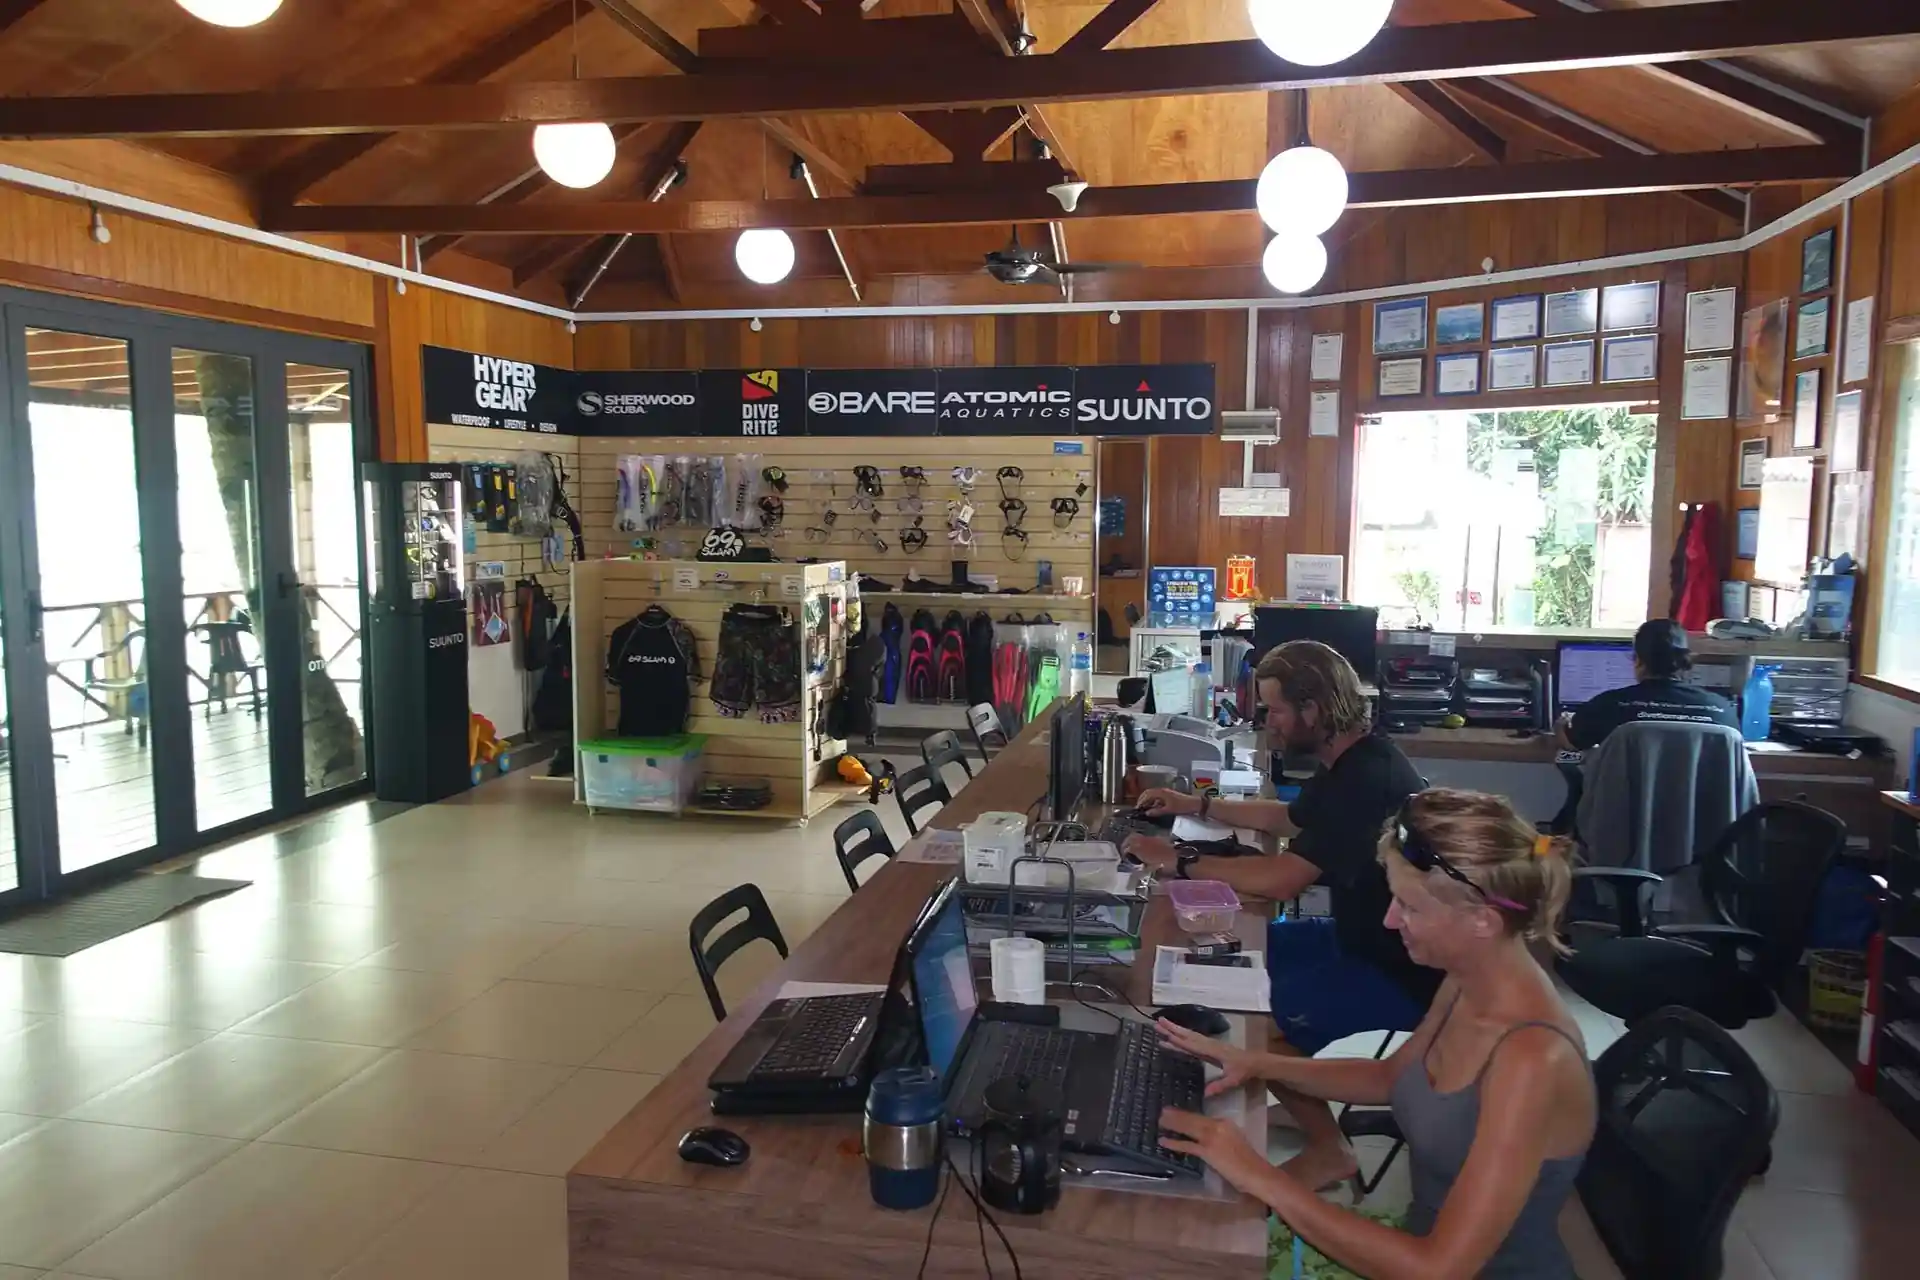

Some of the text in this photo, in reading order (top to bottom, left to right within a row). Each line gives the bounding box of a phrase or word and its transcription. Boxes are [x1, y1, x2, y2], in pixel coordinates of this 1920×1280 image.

[473, 354, 537, 389] HYPER
[475, 381, 530, 412] GEAR
[604, 394, 696, 405] SHERWOOD
[941, 384, 1071, 404] ATOMIC
[603, 405, 645, 414] SCUBA
[838, 391, 936, 414] BARE
[1076, 397, 1212, 422] SUUNTO
[742, 403, 780, 419] DIVE
[940, 408, 1071, 419] AQUATICS
[742, 420, 779, 435] RITE
[704, 530, 735, 547] 69
[701, 547, 737, 558] SLAM
[429, 632, 464, 648] SUUNTO
